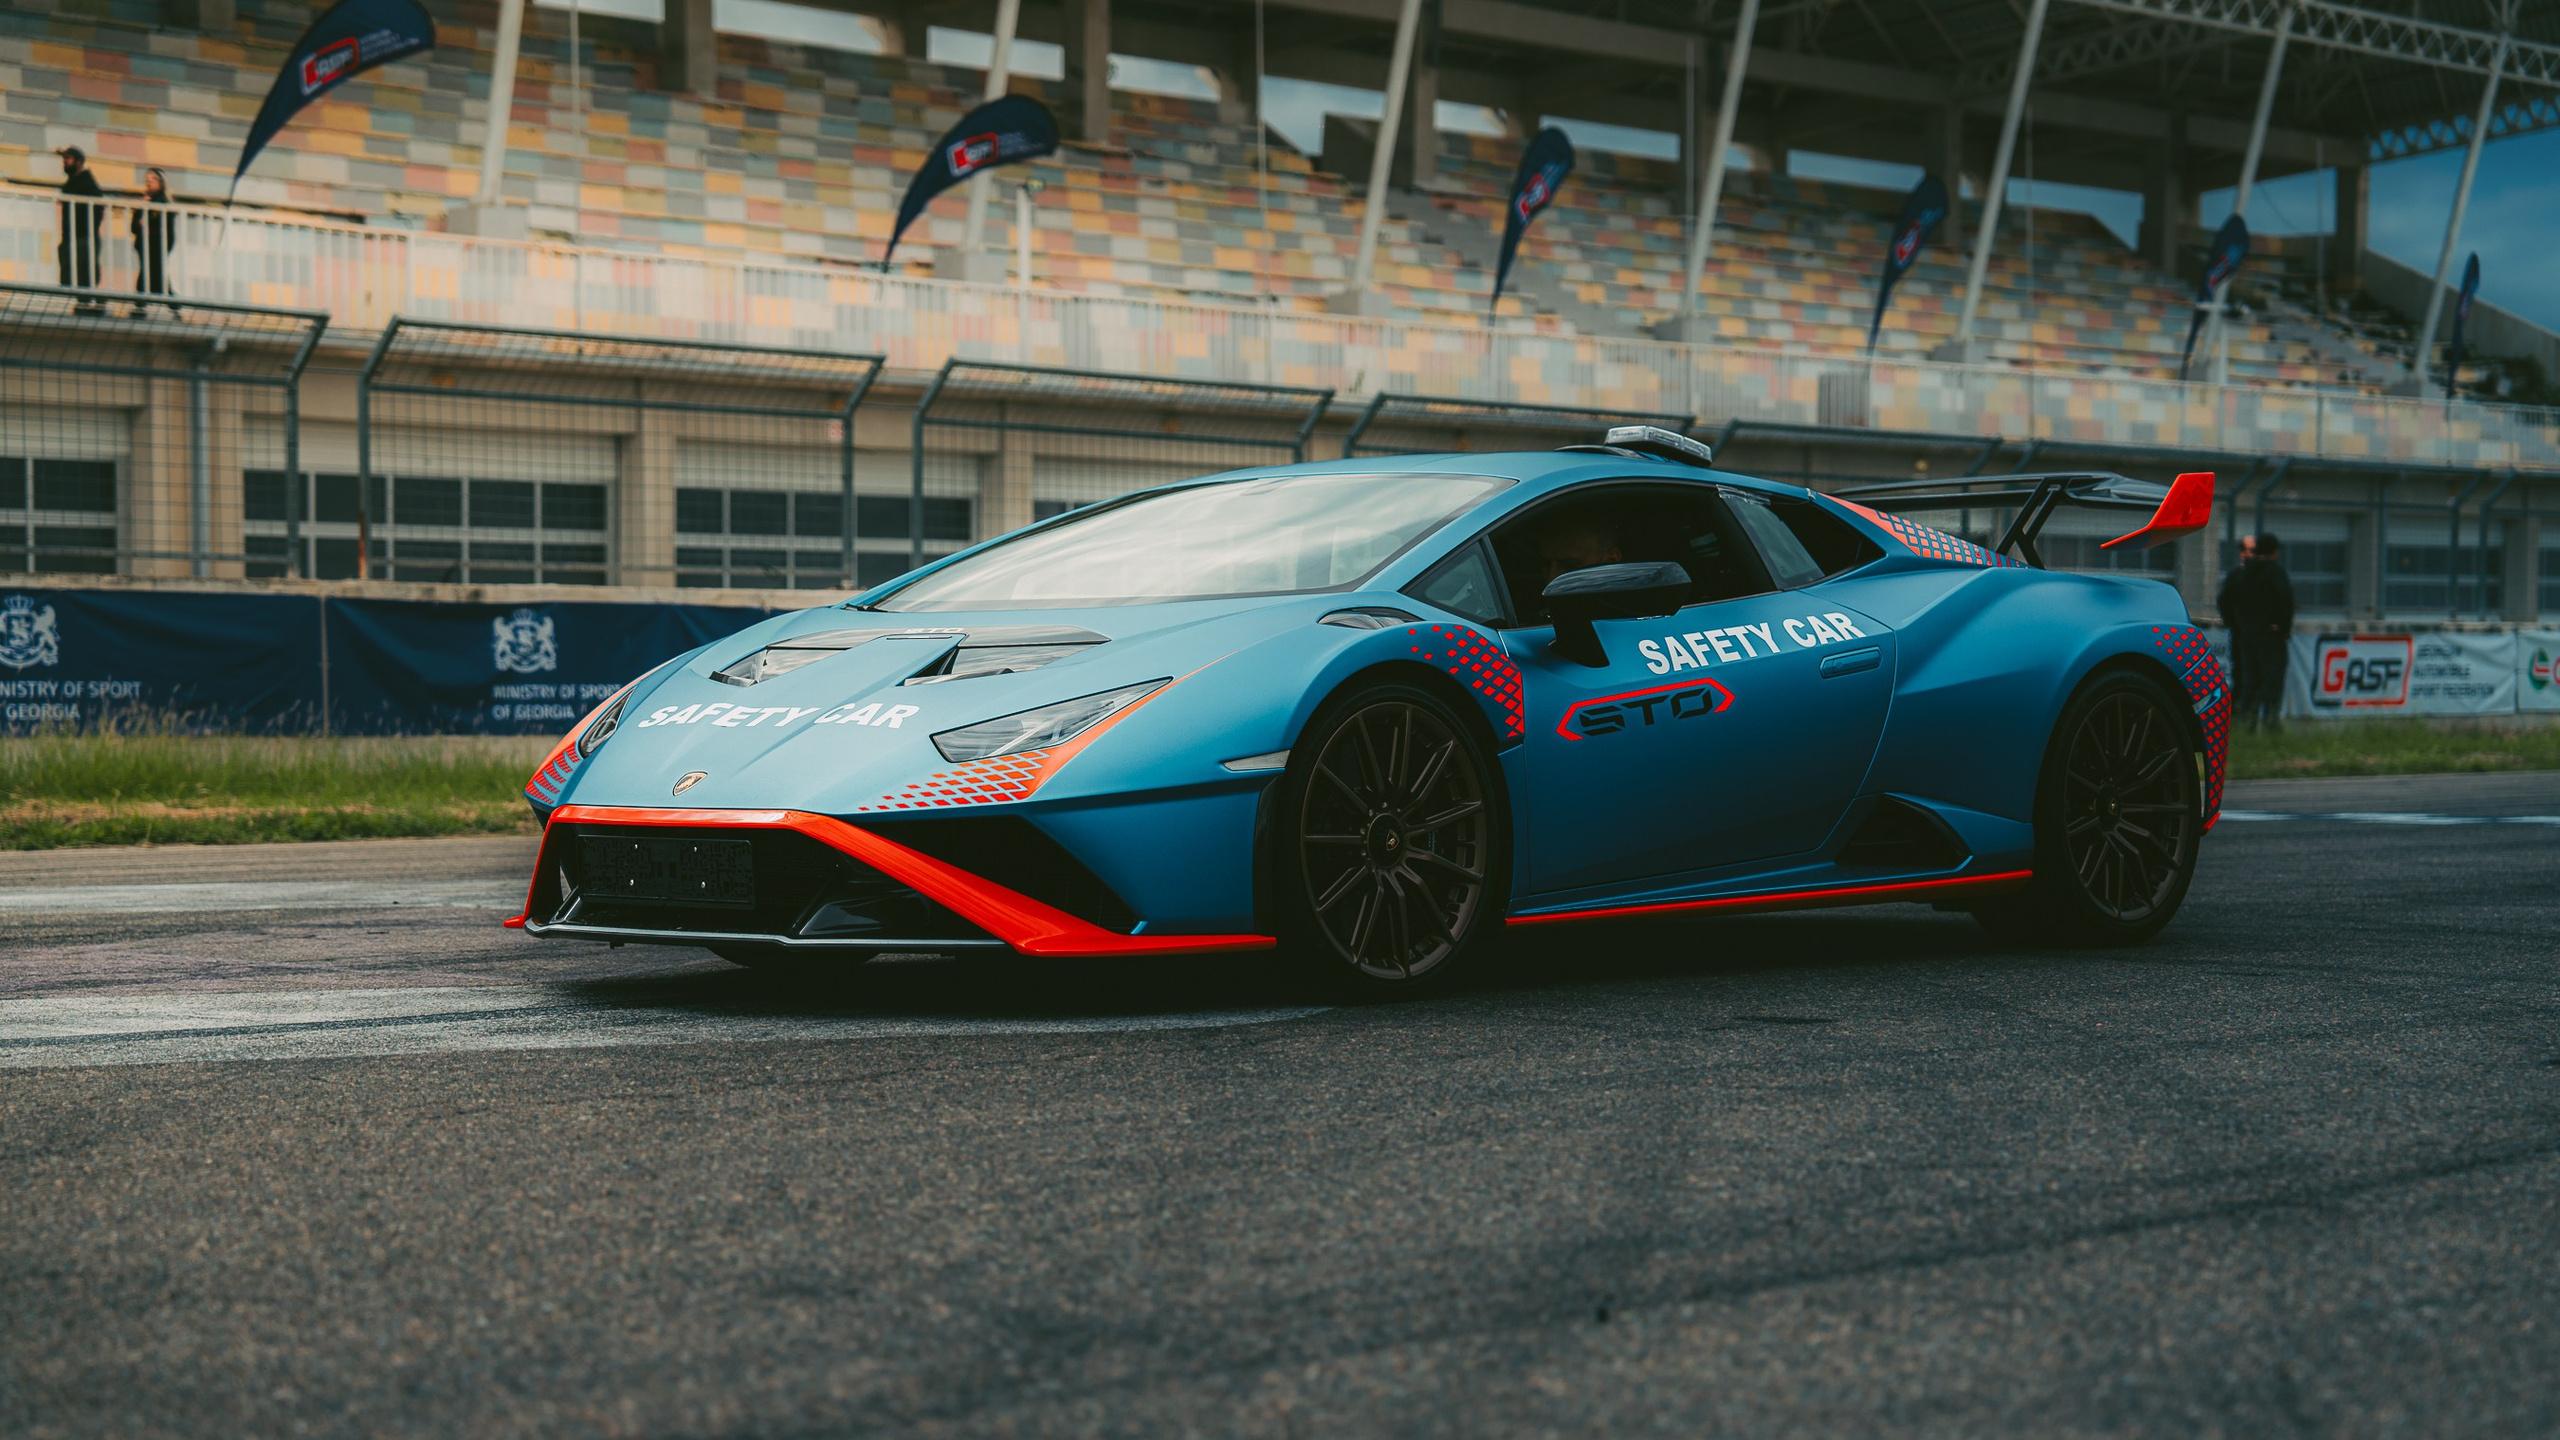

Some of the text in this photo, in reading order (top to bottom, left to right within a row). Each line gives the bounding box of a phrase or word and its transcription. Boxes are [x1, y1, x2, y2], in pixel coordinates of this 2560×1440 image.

[1638, 612, 1867, 675] SAFETY CAR
[2322, 648, 2403, 694] GASF
[63, 680, 84, 698] OF
[88, 680, 141, 699] SPORT
[493, 684, 557, 699] MINISTRY
[560, 684, 577, 699] OF
[6, 703, 80, 720] GEORGIA
[492, 704, 576, 719] OF GEORGIA
[637, 702, 920, 729] SAFETY CAR
[1578, 687, 1713, 737] STO
